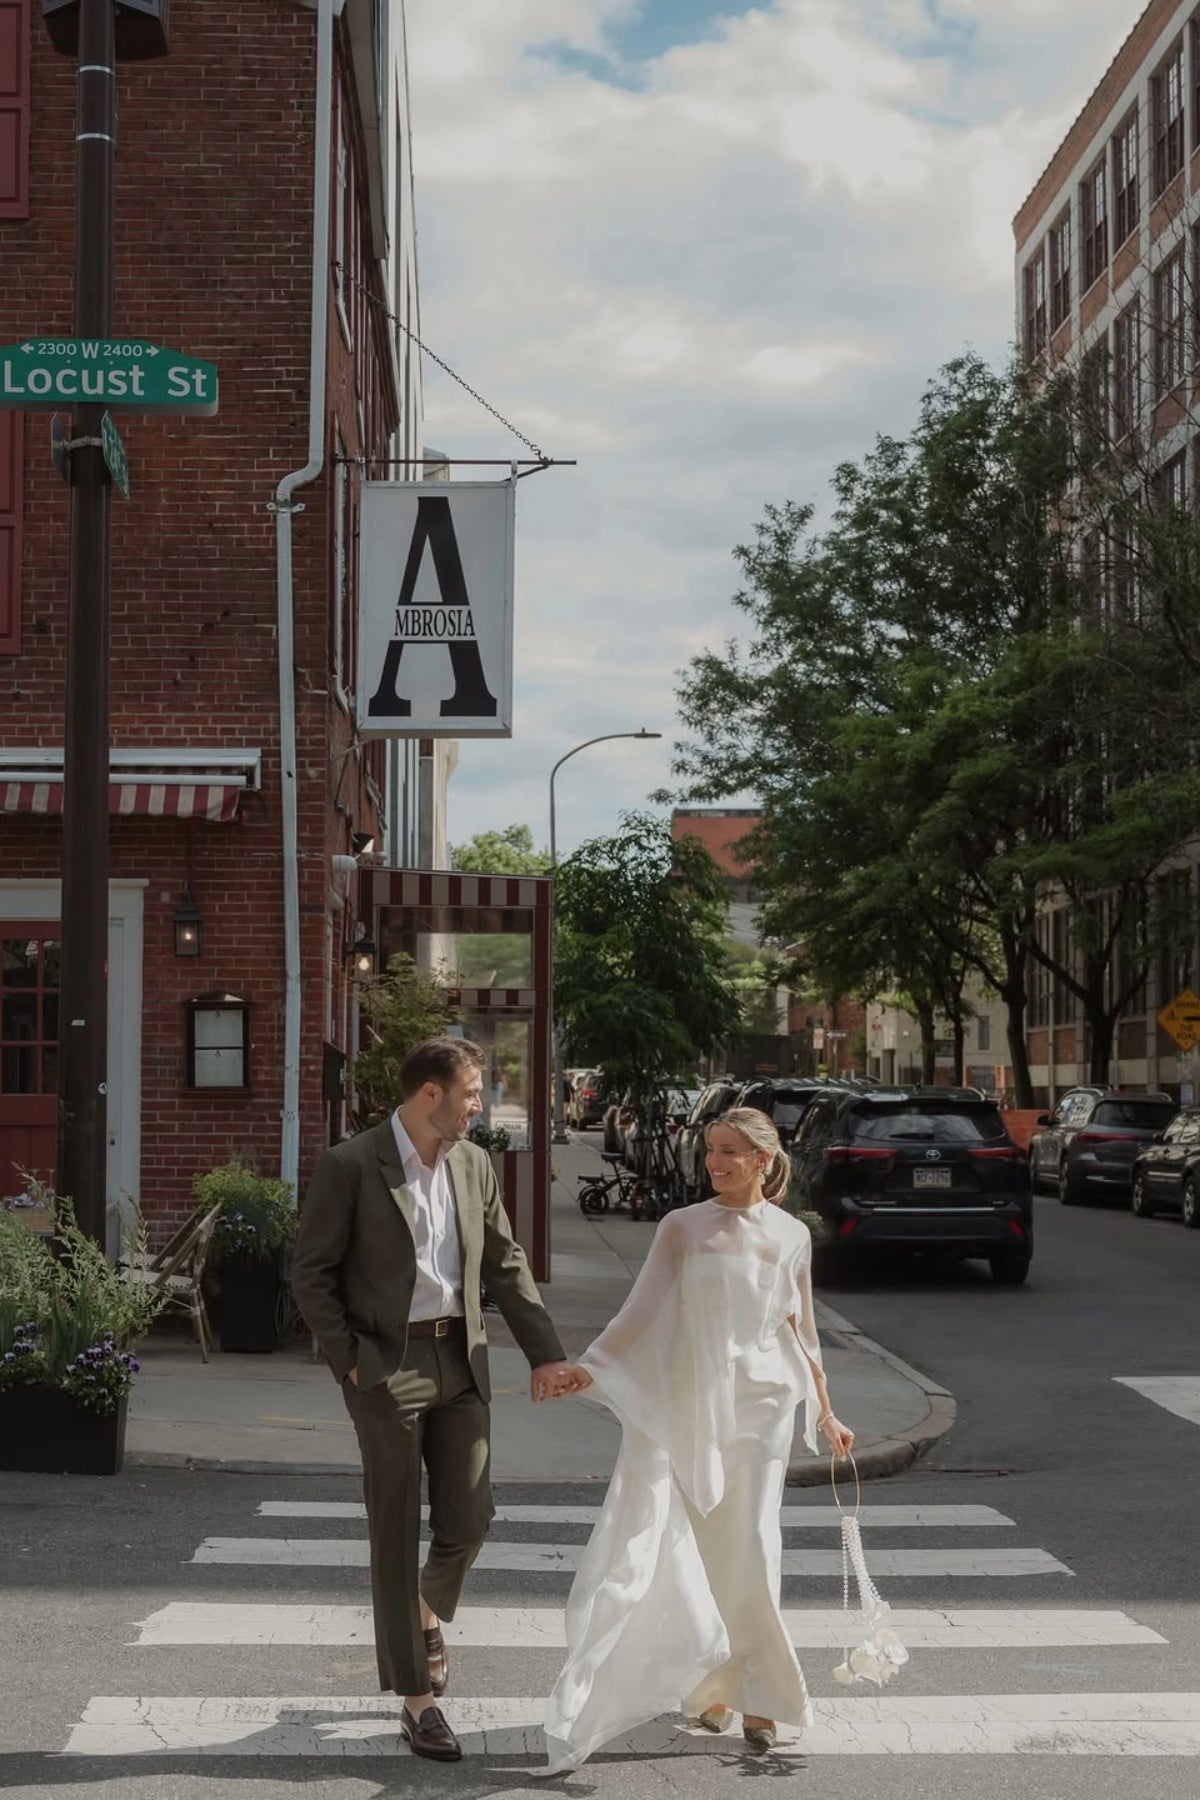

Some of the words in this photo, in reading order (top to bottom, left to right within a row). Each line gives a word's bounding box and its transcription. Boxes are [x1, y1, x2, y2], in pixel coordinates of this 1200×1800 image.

[38, 342, 77, 356] 2300
[82, 342, 99, 359] W
[103, 344, 143, 357] 2400
[4, 360, 145, 397] Locust
[167, 366, 208, 397] St
